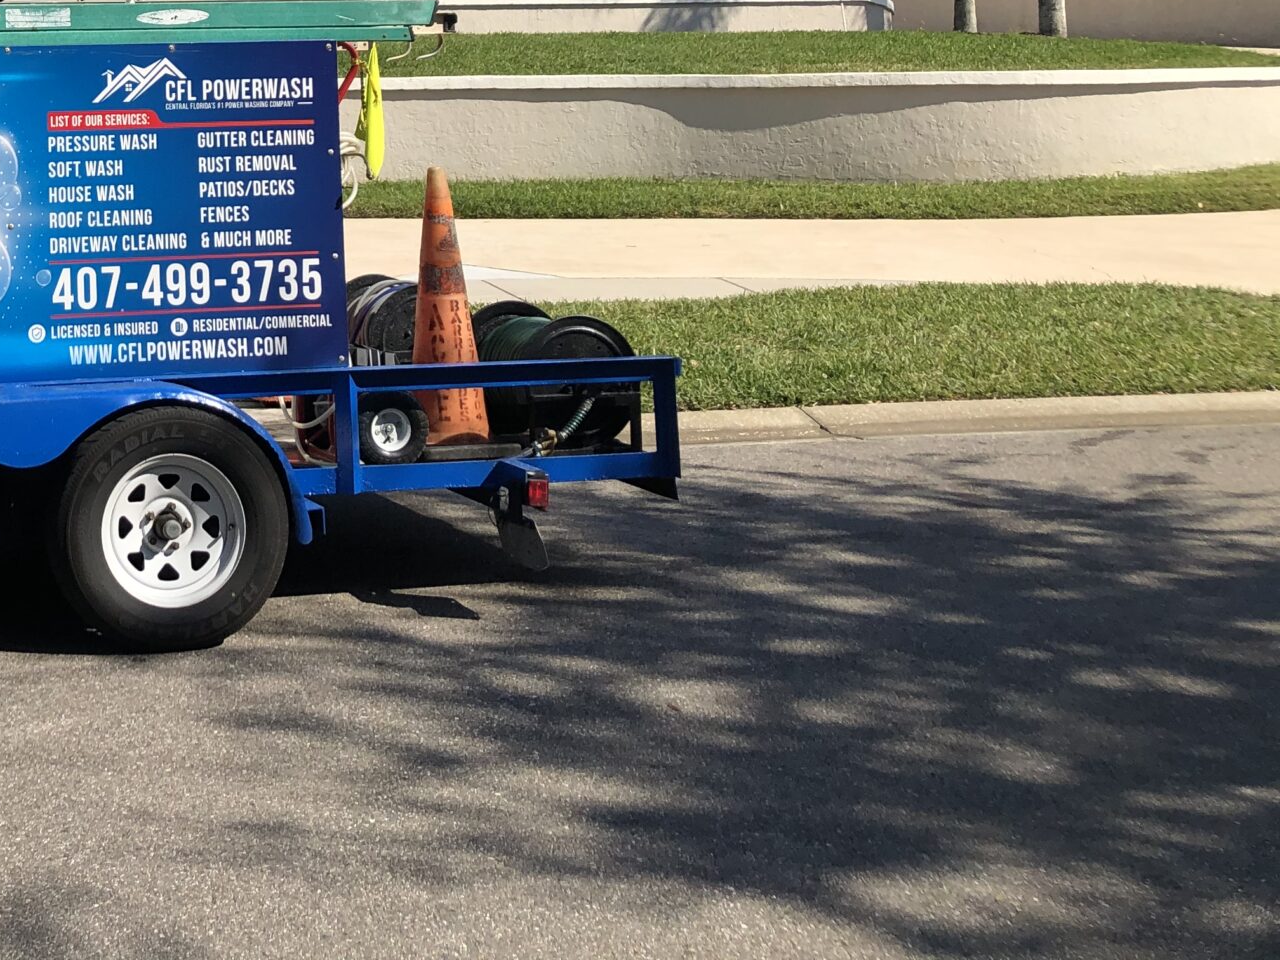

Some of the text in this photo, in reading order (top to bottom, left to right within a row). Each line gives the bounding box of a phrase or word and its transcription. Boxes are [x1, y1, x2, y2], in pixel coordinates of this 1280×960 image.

[165, 78, 313, 102] CFL POWERWASH
[50, 114, 150, 127] LIST OF OUR SERVICES:
[48, 134, 157, 152] PRESSURE WASH
[197, 130, 314, 148] GUTTER CLEANING
[48, 160, 123, 177] SOFT WASH
[198, 155, 296, 172] RUST REMOVAL
[49, 185, 134, 203] HOUSE WASH
[199, 180, 295, 198] PATIOS/DECKS
[50, 210, 152, 228] ROOF CLEANING
[200, 206, 249, 223] FENCES
[50, 234, 187, 253] DRIVEWAY CLEANING
[201, 230, 292, 247] & MUCH MORE
[52, 258, 322, 310] 407-499-3735
[51, 322, 158, 338] LICENSED & INSURED
[193, 315, 332, 332] RESIDENTIAL/COMMERCIAL
[69, 337, 288, 365] WWW.CFLPOWERWASH.COM
